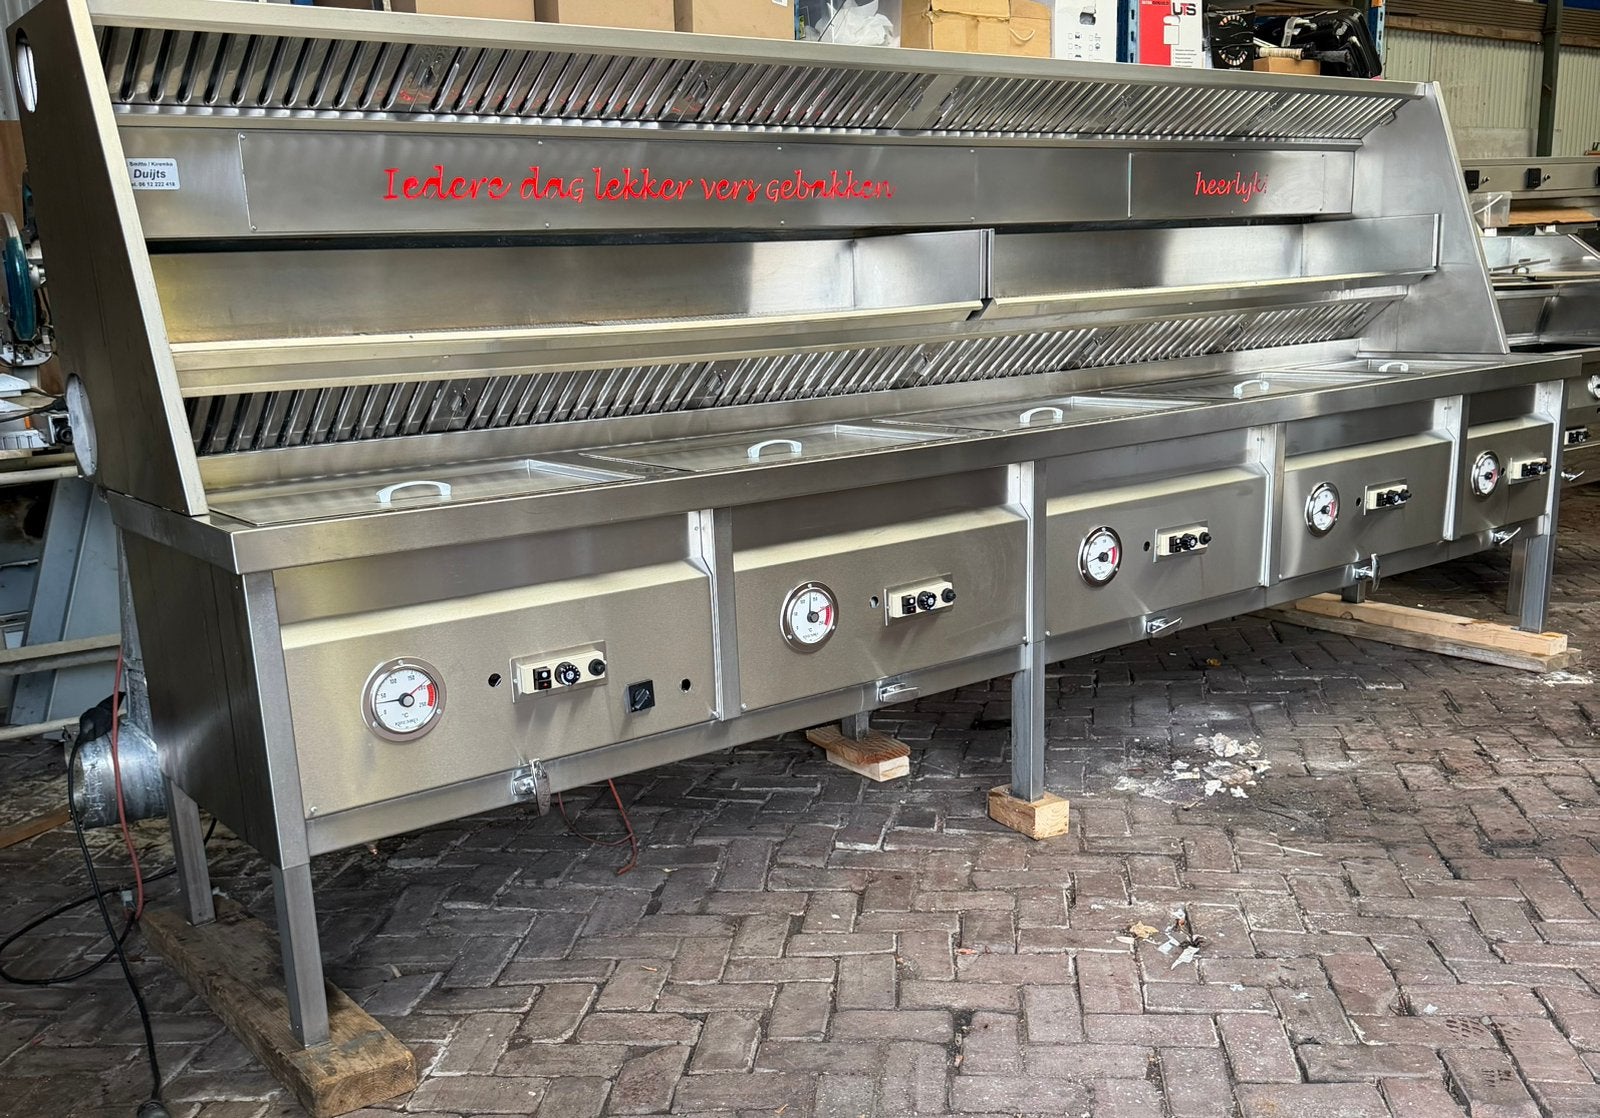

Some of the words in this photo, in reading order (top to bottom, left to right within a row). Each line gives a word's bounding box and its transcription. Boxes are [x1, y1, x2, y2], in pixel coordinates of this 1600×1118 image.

[133, 168, 167, 181] Duijts
[383, 165, 512, 201] Iedere
[519, 166, 585, 204] dag
[592, 167, 694, 201] lekker
[700, 177, 763, 204] vers
[765, 169, 897, 203] gebakken
